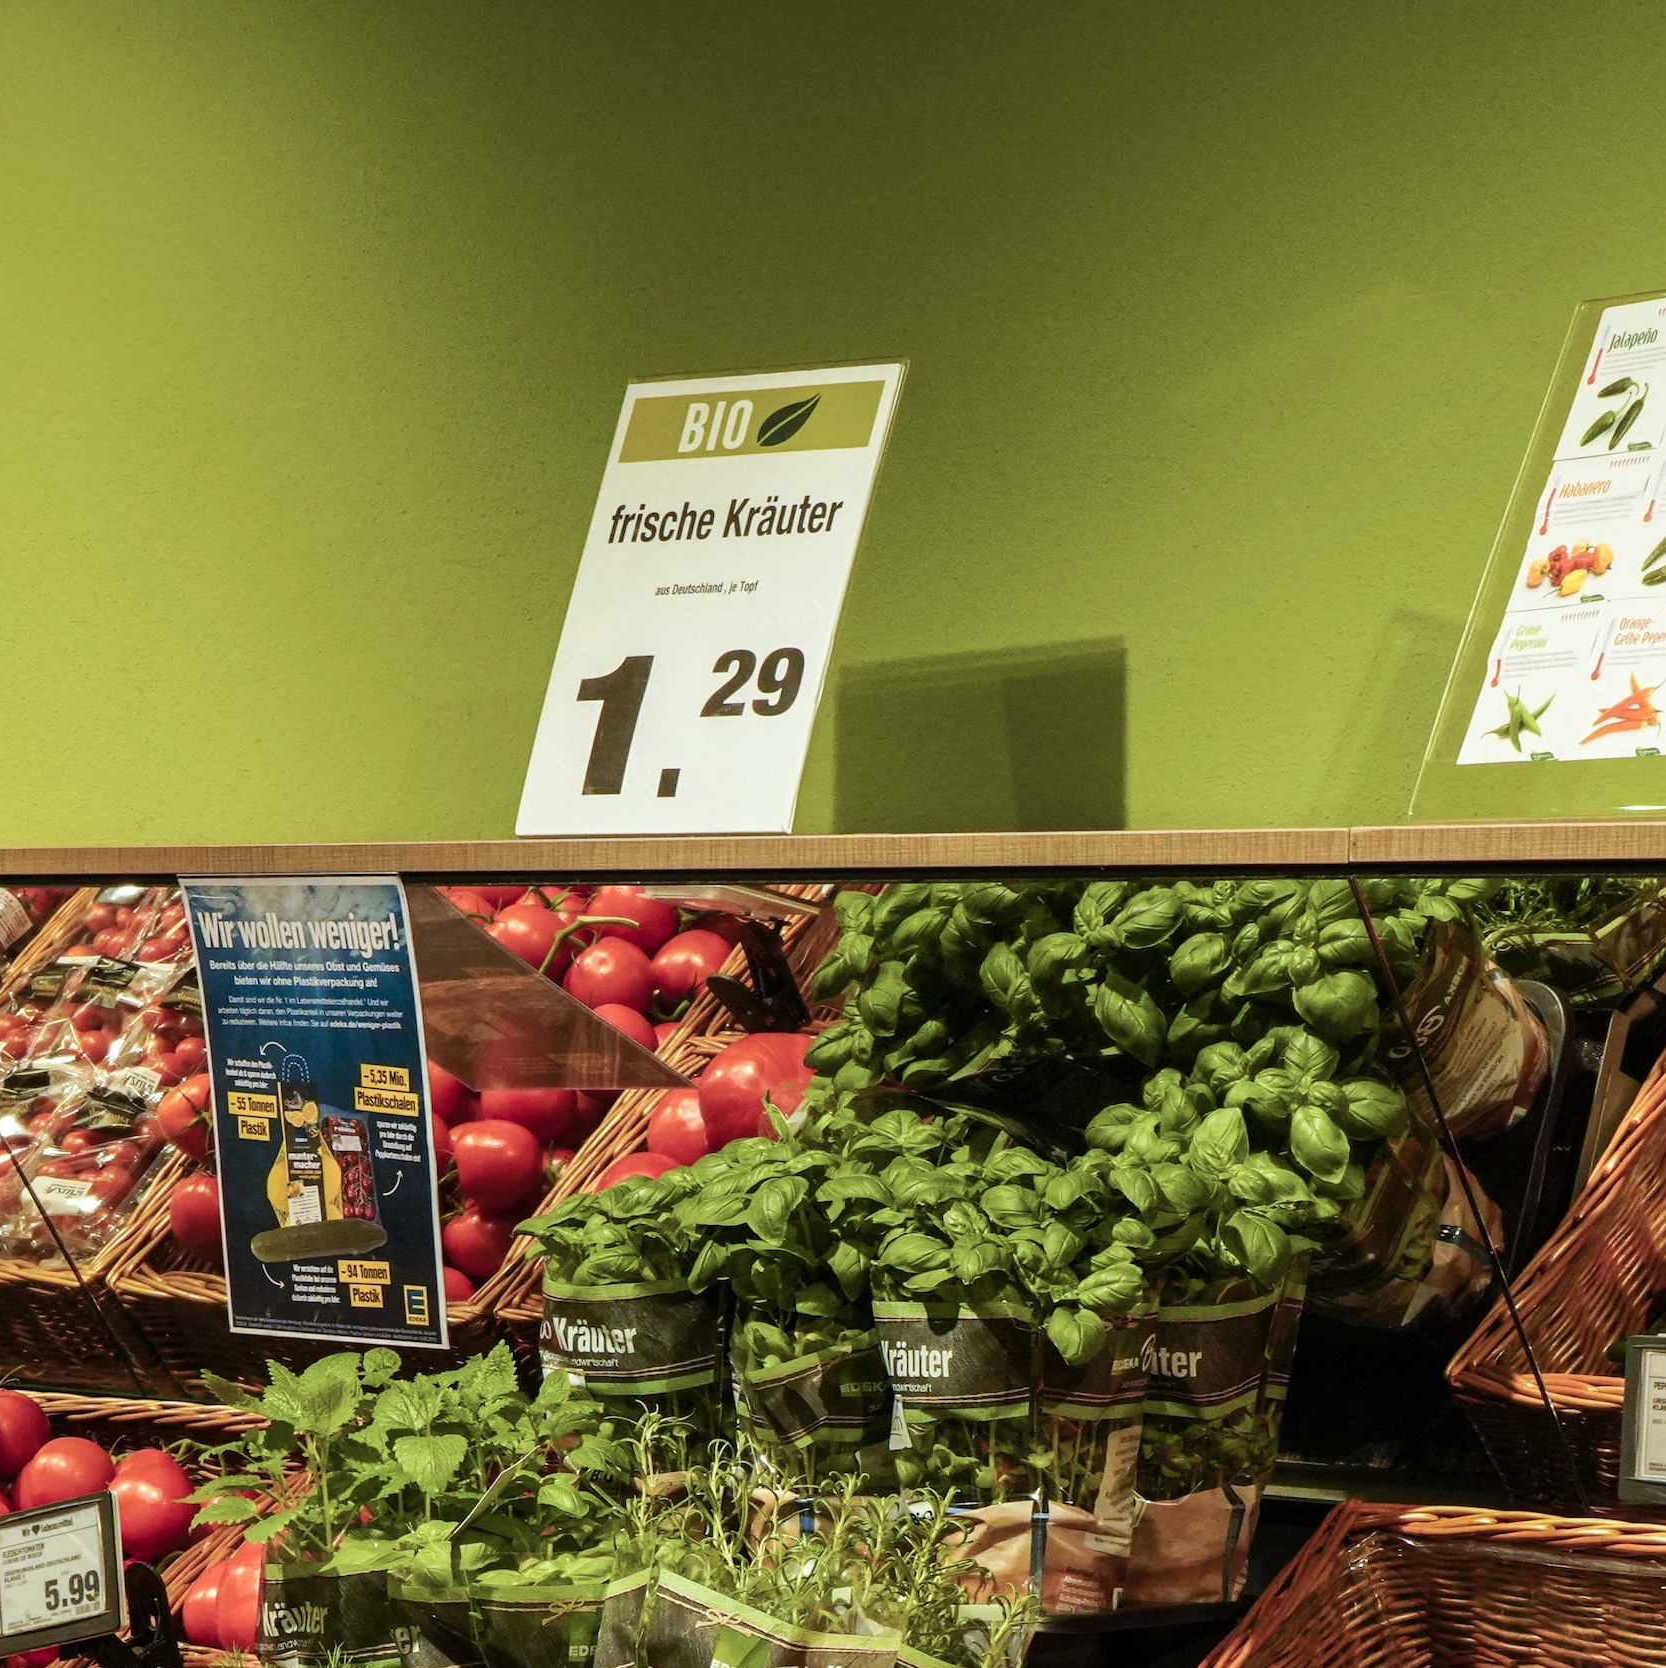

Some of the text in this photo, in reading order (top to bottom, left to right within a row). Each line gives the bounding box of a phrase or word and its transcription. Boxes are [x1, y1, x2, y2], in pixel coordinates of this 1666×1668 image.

[1607, 328, 1658, 353] Jalapeño
[678, 399, 753, 453] BIO
[1559, 479, 1612, 499] Habanero
[608, 495, 844, 544] frische Kräuter
[655, 580, 759, 596] aus Deutschland je Topf
[1619, 617, 1655, 631] Orange-
[1509, 638, 1547, 651] Peperoni
[1614, 633, 1640, 646] Gelbe
[197, 912, 400, 959] Wir wollen weniger!
[294, 977, 364, 989] Plastikverpackung
[248, 1099, 274, 1114] Tonnen
[357, 1092, 416, 1112] Plastikschalen
[241, 1120, 267, 1137] Plastik
[358, 1264, 387, 1280] Tonnen
[353, 1288, 381, 1303] Plastik
[553, 1317, 638, 1355] Kräuter
[44, 1569, 101, 1611] 5.99
